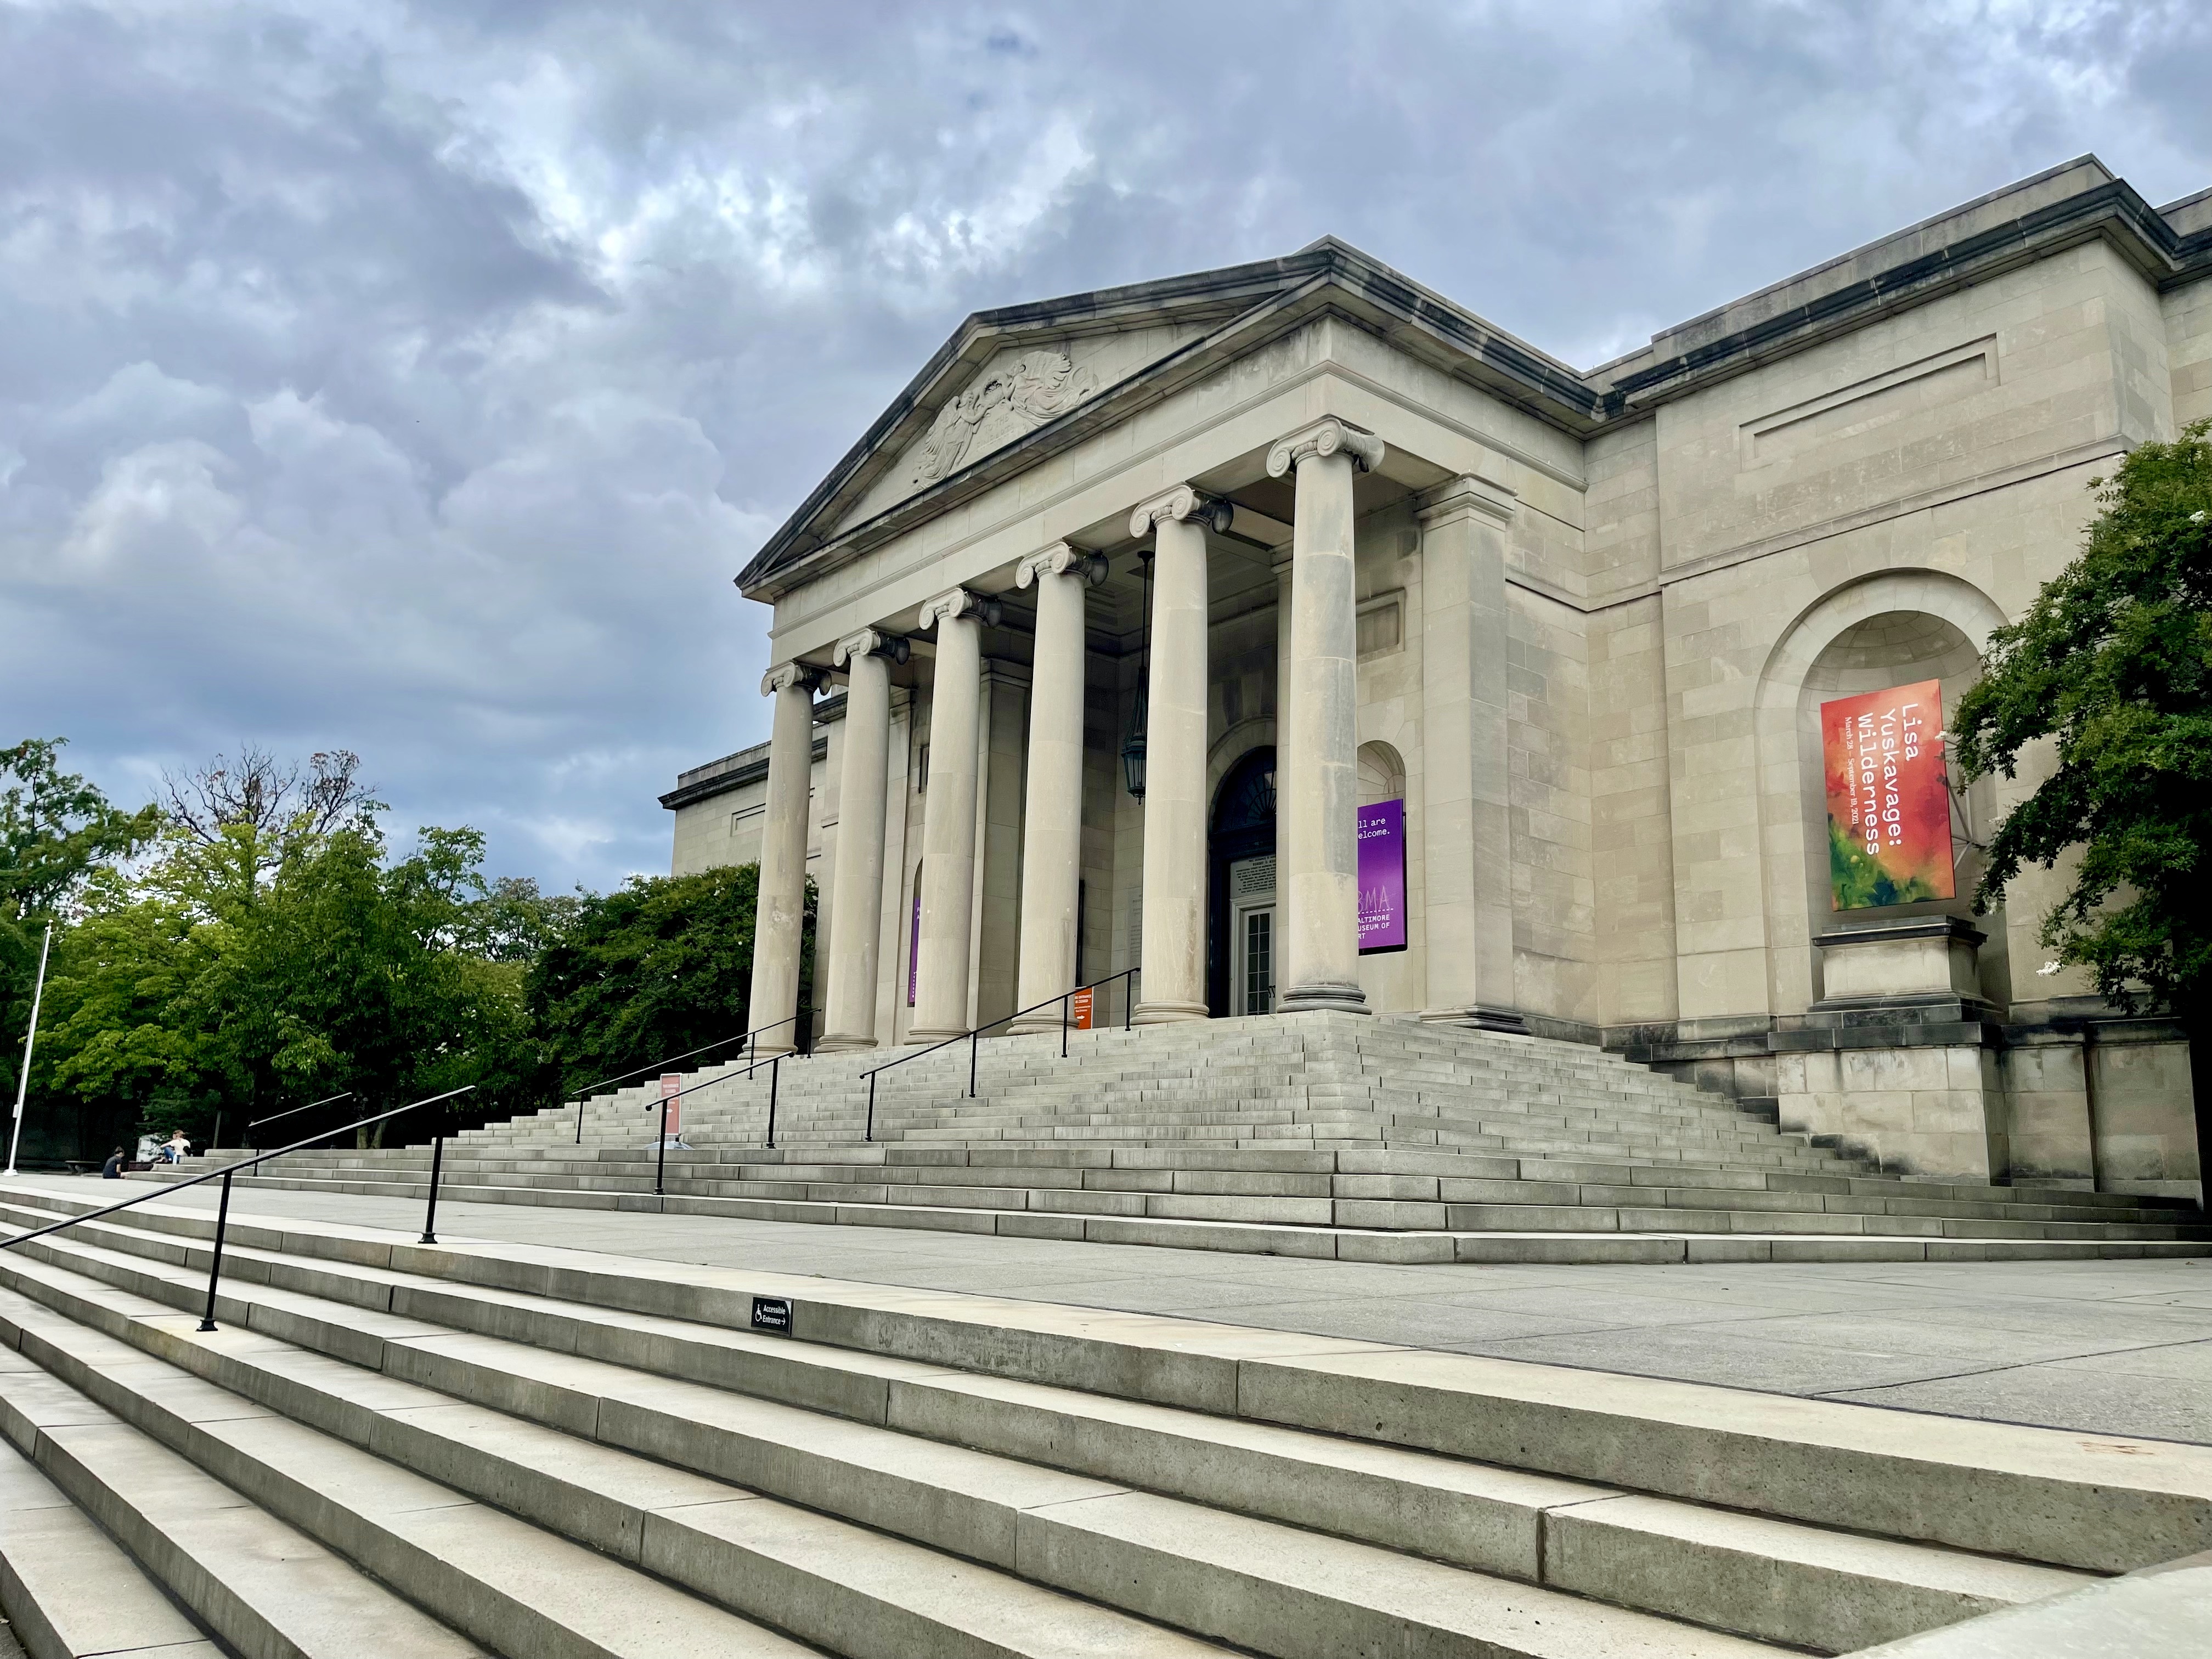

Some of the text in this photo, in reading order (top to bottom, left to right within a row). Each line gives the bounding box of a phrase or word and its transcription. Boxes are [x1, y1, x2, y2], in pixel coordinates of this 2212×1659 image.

[1844, 716, 1853, 740] March
[1902, 703, 1922, 761] Lisa
[1847, 740, 1854, 749] 28
[1847, 758, 1857, 797] September
[1880, 708, 1902, 846] Yuskavage:
[1858, 712, 1880, 855] Wilderness
[1358, 818, 1386, 829] ll are
[1358, 829, 1390, 839] elcome.
[1358, 914, 1390, 924] ALTIMORE
[1358, 923, 1379, 932] USEUM
[763, 1304, 786, 1315] Accessible
[763, 1314, 781, 1325] Entrance
